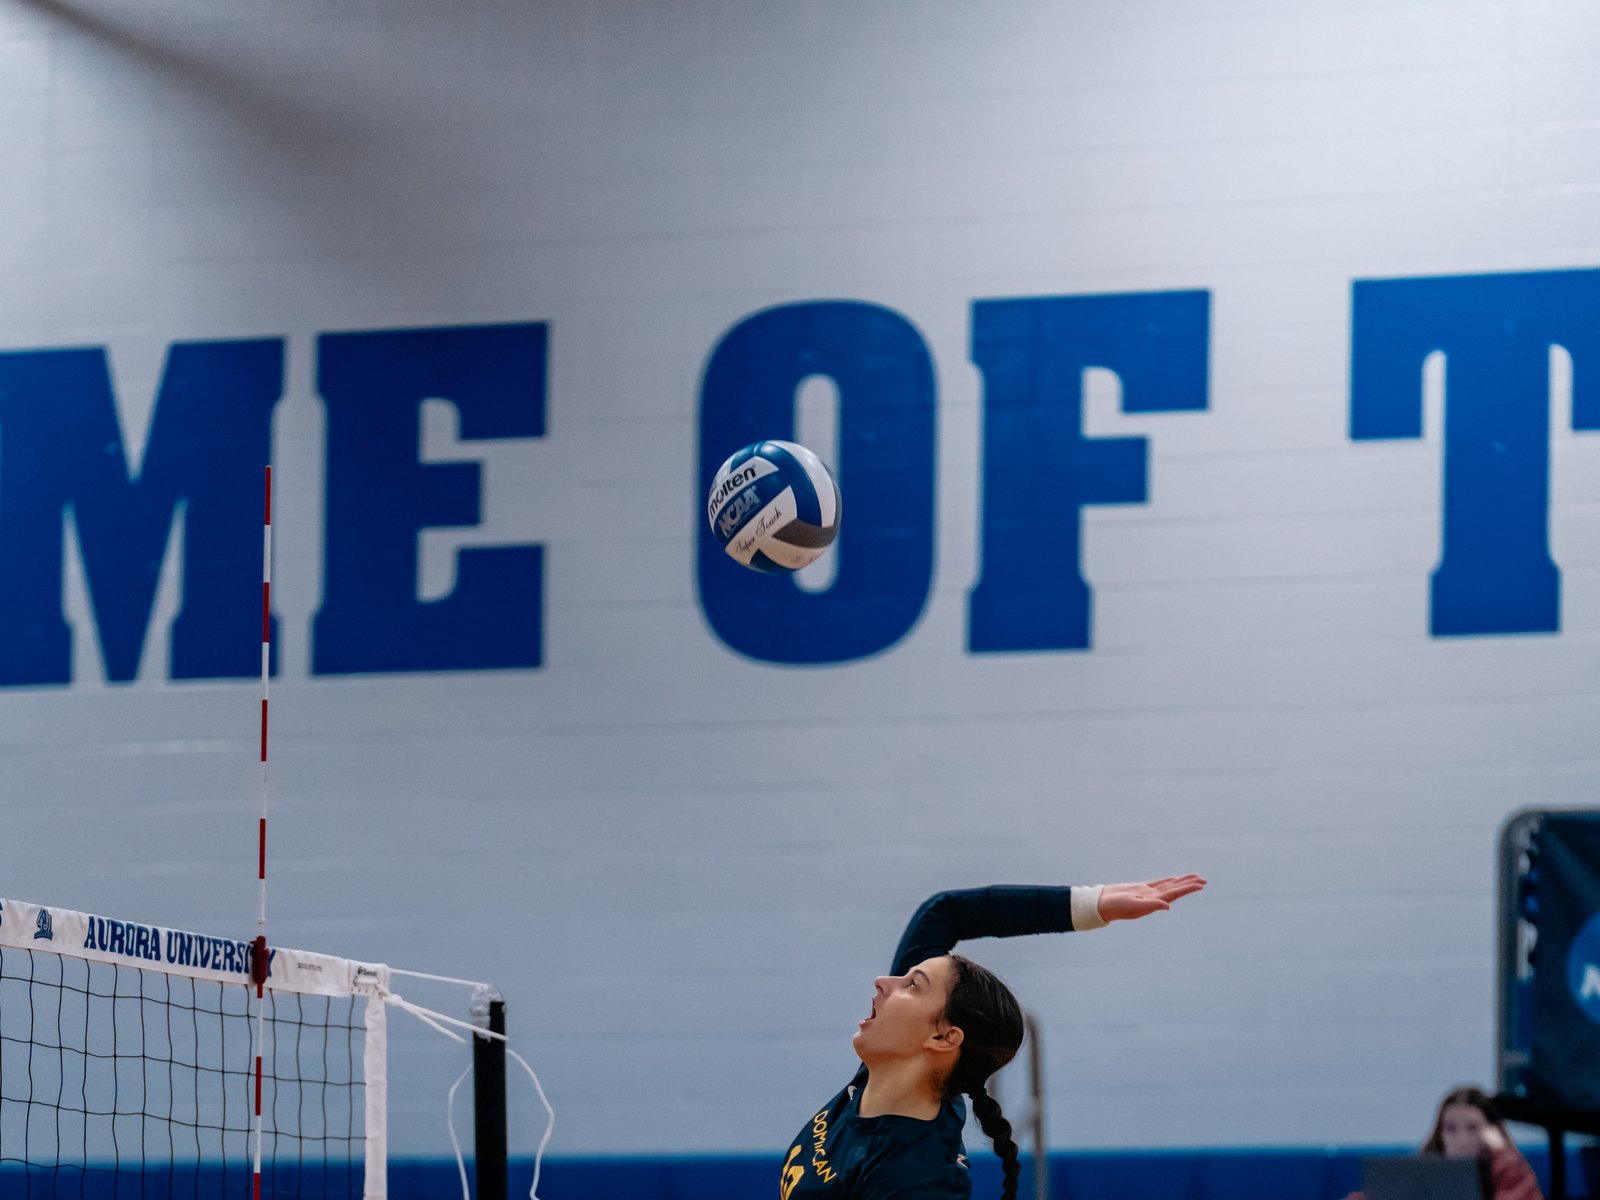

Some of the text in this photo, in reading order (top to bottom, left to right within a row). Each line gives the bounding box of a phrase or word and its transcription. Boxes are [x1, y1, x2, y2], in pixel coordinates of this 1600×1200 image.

[0, 320, 548, 688] ME
[697, 288, 1212, 668] OF
[709, 467, 757, 519] molten
[717, 487, 762, 538] NCAA
[756, 507, 782, 535] Touch
[83, 915, 161, 961] AURORA
